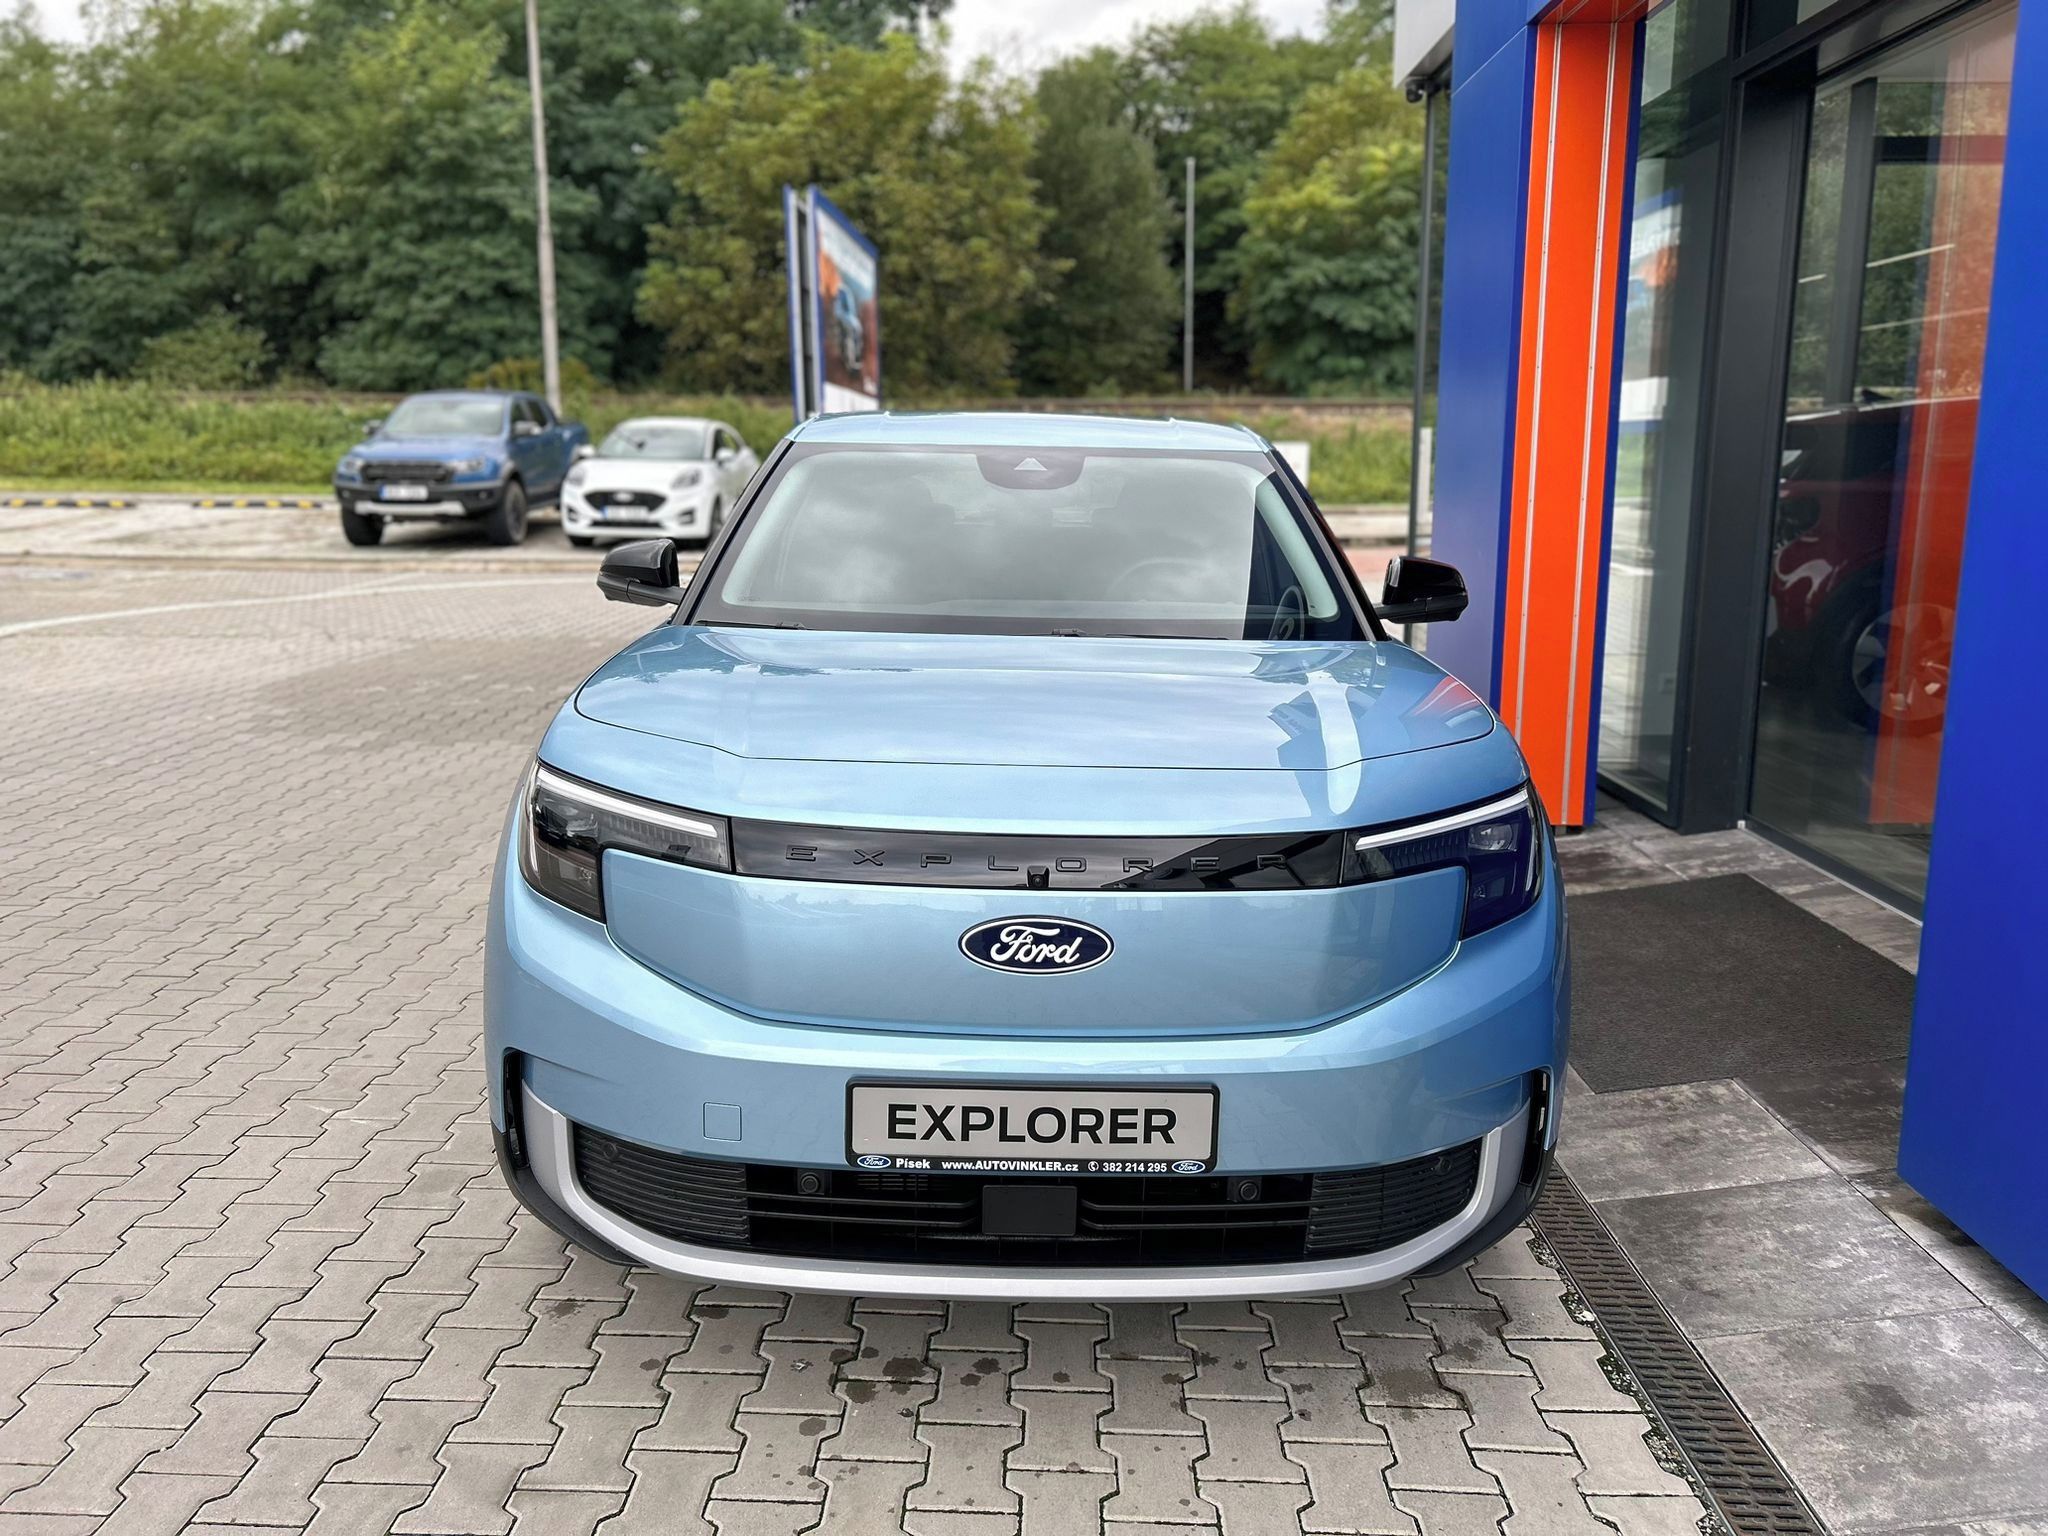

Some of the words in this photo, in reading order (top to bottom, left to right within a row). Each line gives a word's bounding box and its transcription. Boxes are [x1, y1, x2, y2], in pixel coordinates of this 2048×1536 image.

[785, 844, 1288, 874] EXPLORER
[989, 924, 1083, 965] Ford
[887, 1102, 1178, 1145] EXPLORER
[895, 1157, 931, 1169] Písek
[941, 1159, 1079, 1172] www.AUTOVINKLER.cz
[1102, 1161, 1123, 1172] 382
[1125, 1161, 1145, 1173] 214
[1147, 1162, 1168, 1173] 295
